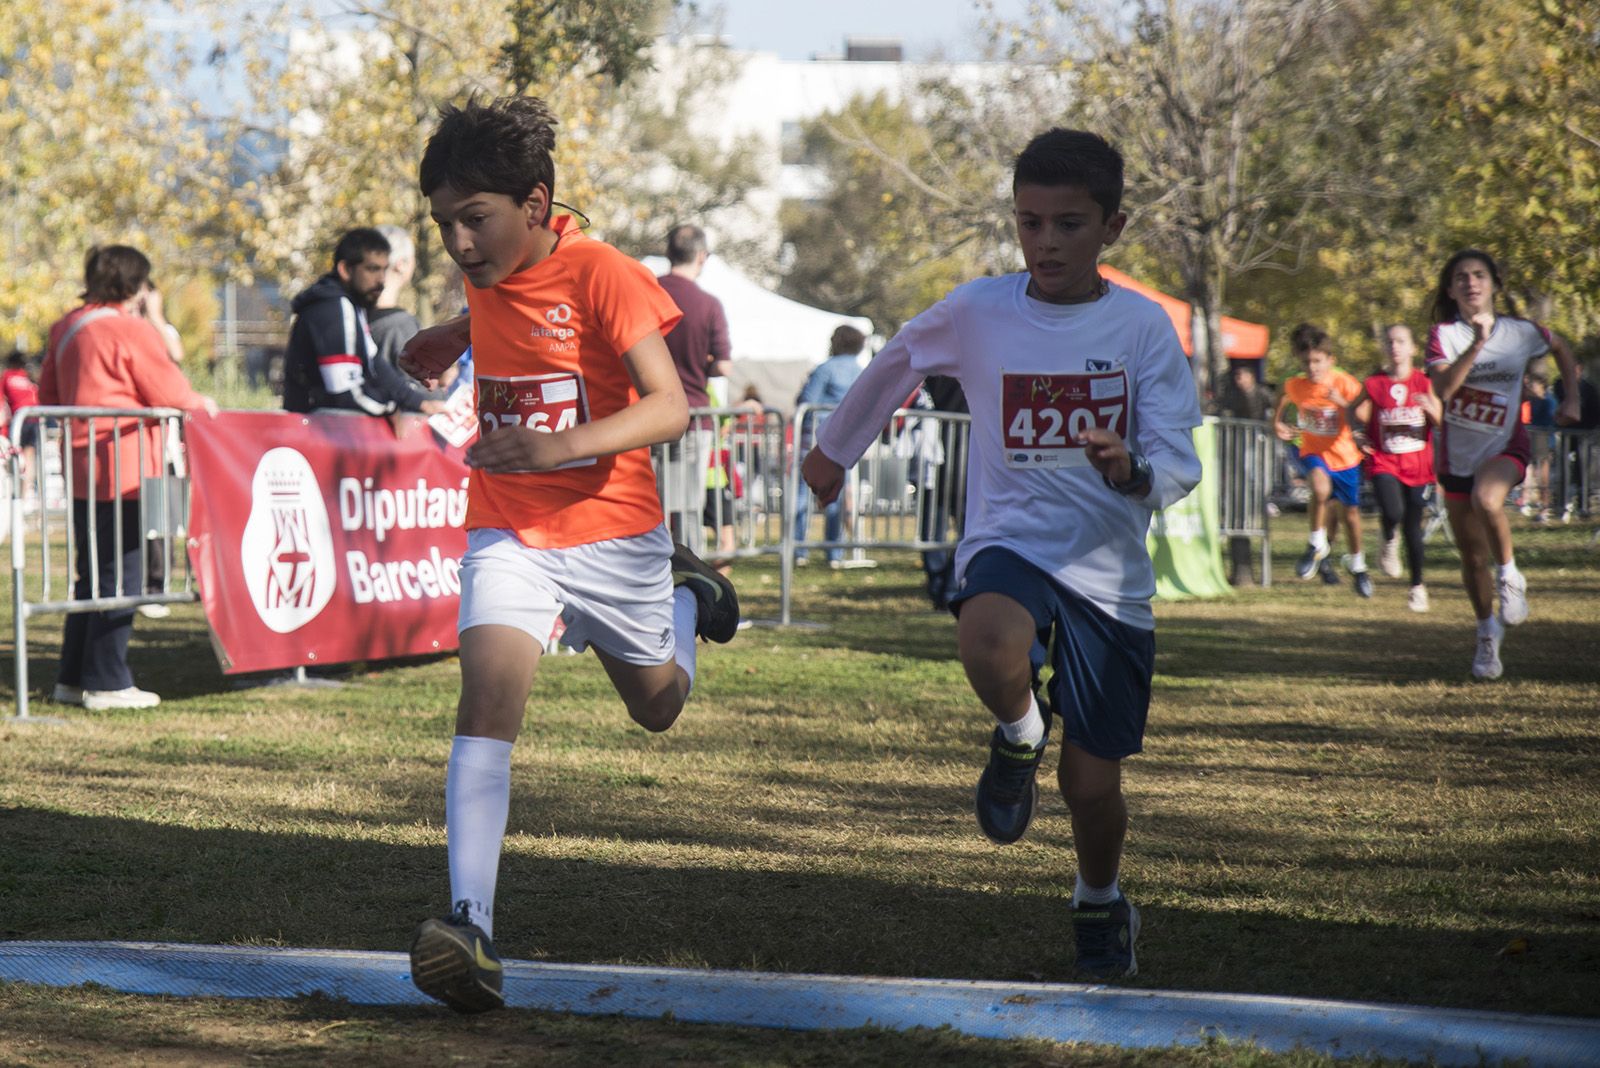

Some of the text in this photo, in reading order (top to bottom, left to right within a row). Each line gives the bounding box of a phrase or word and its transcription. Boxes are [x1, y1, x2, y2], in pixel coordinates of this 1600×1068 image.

[548, 342, 576, 353] AMPA
[1390, 383, 1408, 407] 9
[1008, 403, 1124, 446] 4207
[1451, 399, 1505, 425] 1477
[345, 545, 464, 604] Barcelo
